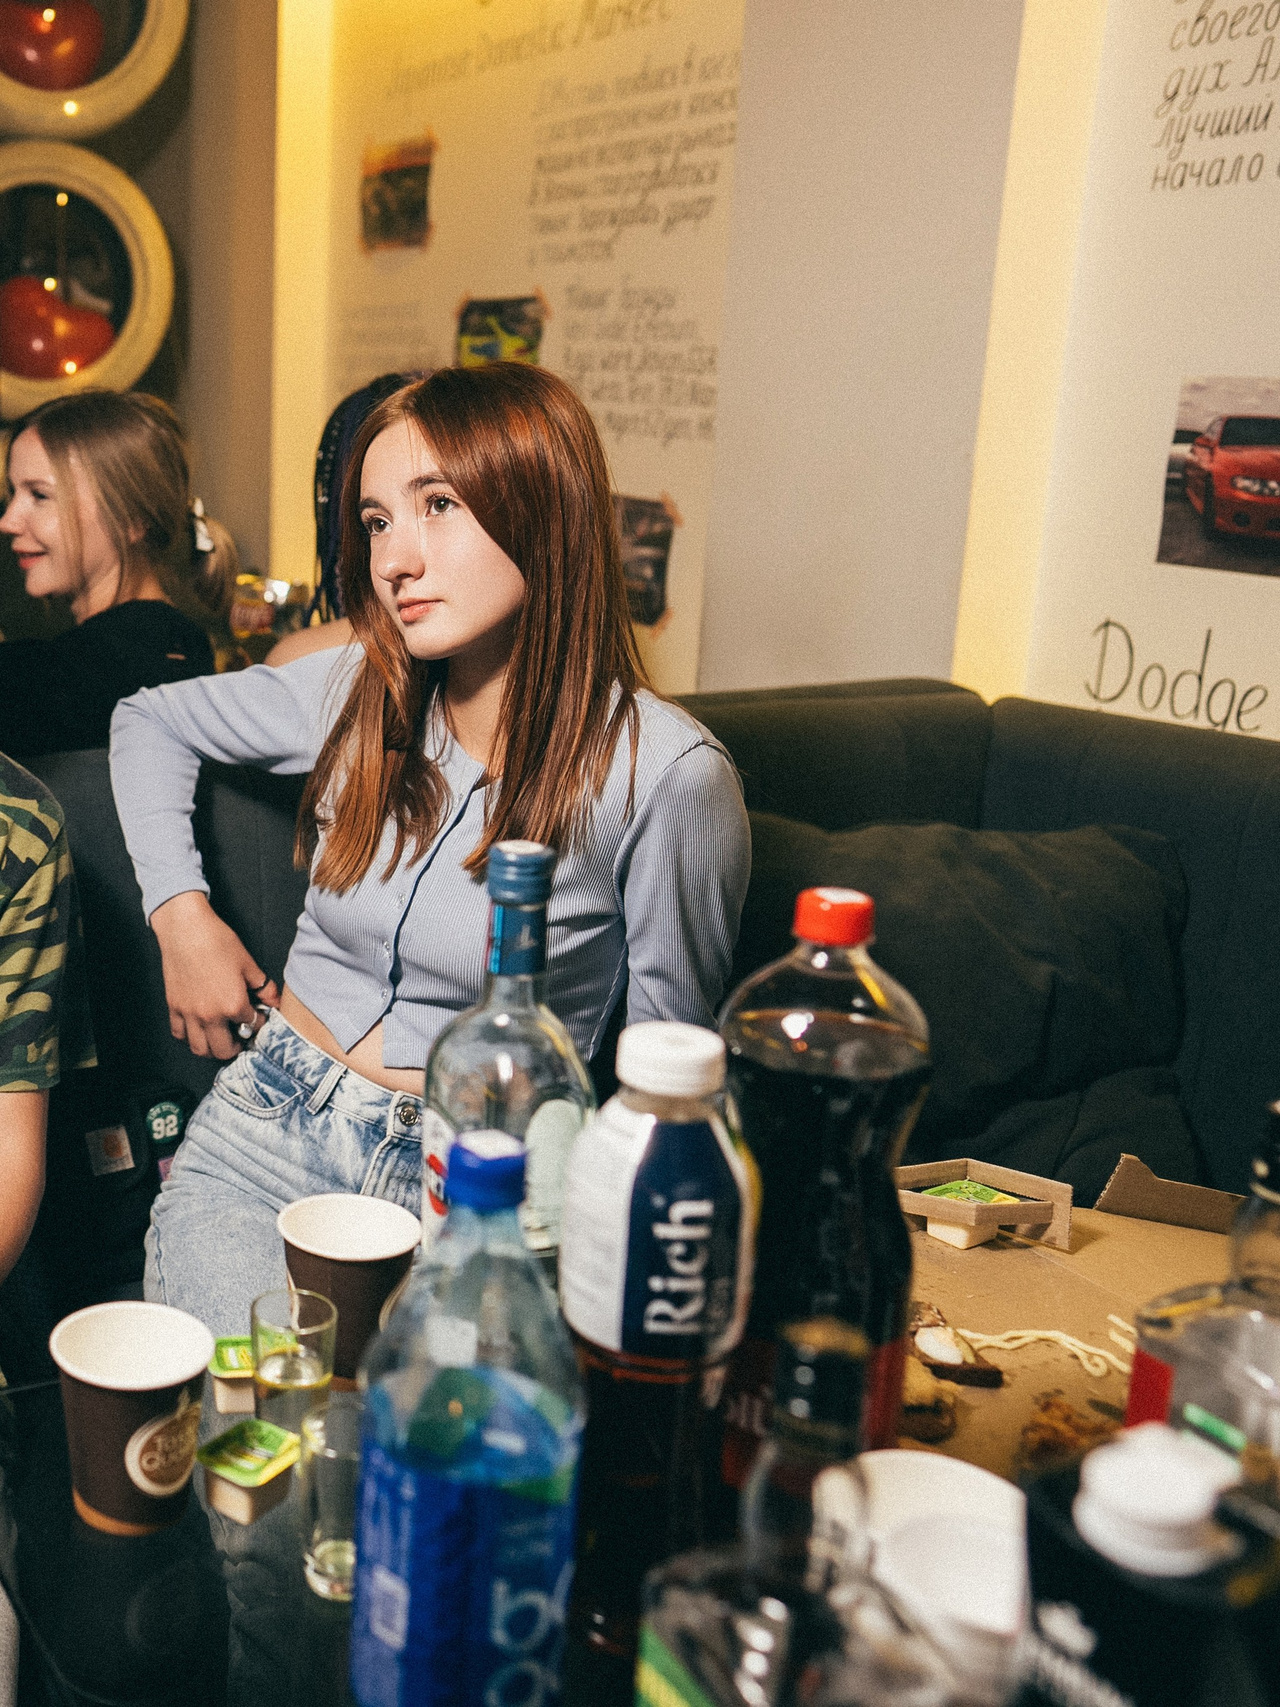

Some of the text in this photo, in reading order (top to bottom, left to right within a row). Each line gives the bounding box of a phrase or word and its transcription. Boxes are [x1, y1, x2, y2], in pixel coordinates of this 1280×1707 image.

[1154, 58, 1232, 119] дух
[1151, 93, 1275, 163] лучший
[1150, 152, 1265, 192] начало
[1084, 617, 1269, 734] Dodge
[151, 1113, 179, 1141] 92
[642, 1199, 715, 1335] Rich
